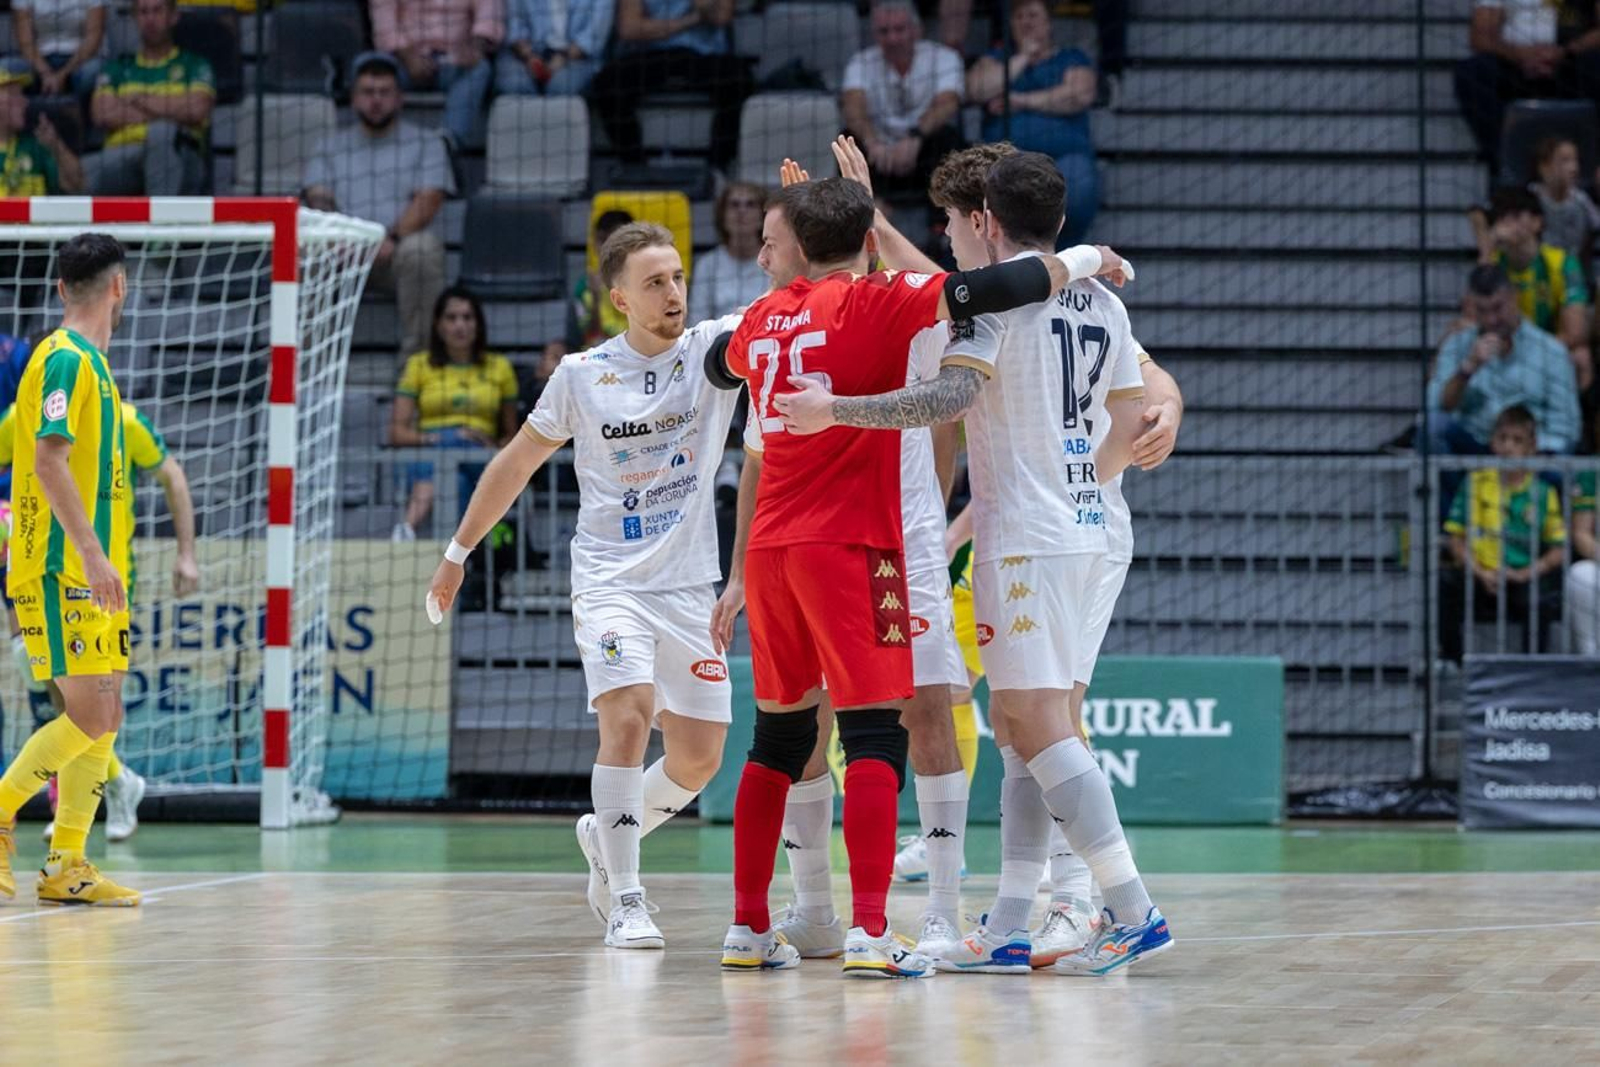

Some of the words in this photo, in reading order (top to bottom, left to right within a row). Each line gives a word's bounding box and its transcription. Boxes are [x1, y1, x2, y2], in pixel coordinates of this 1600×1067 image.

[644, 371, 657, 395] 8
[748, 330, 832, 433] 25
[602, 422, 652, 440] Celta
[644, 509, 680, 525] XUNTA
[645, 525, 660, 536] DE
[1081, 698, 1233, 738] URAL
[1484, 706, 1600, 731] Mercedes-
